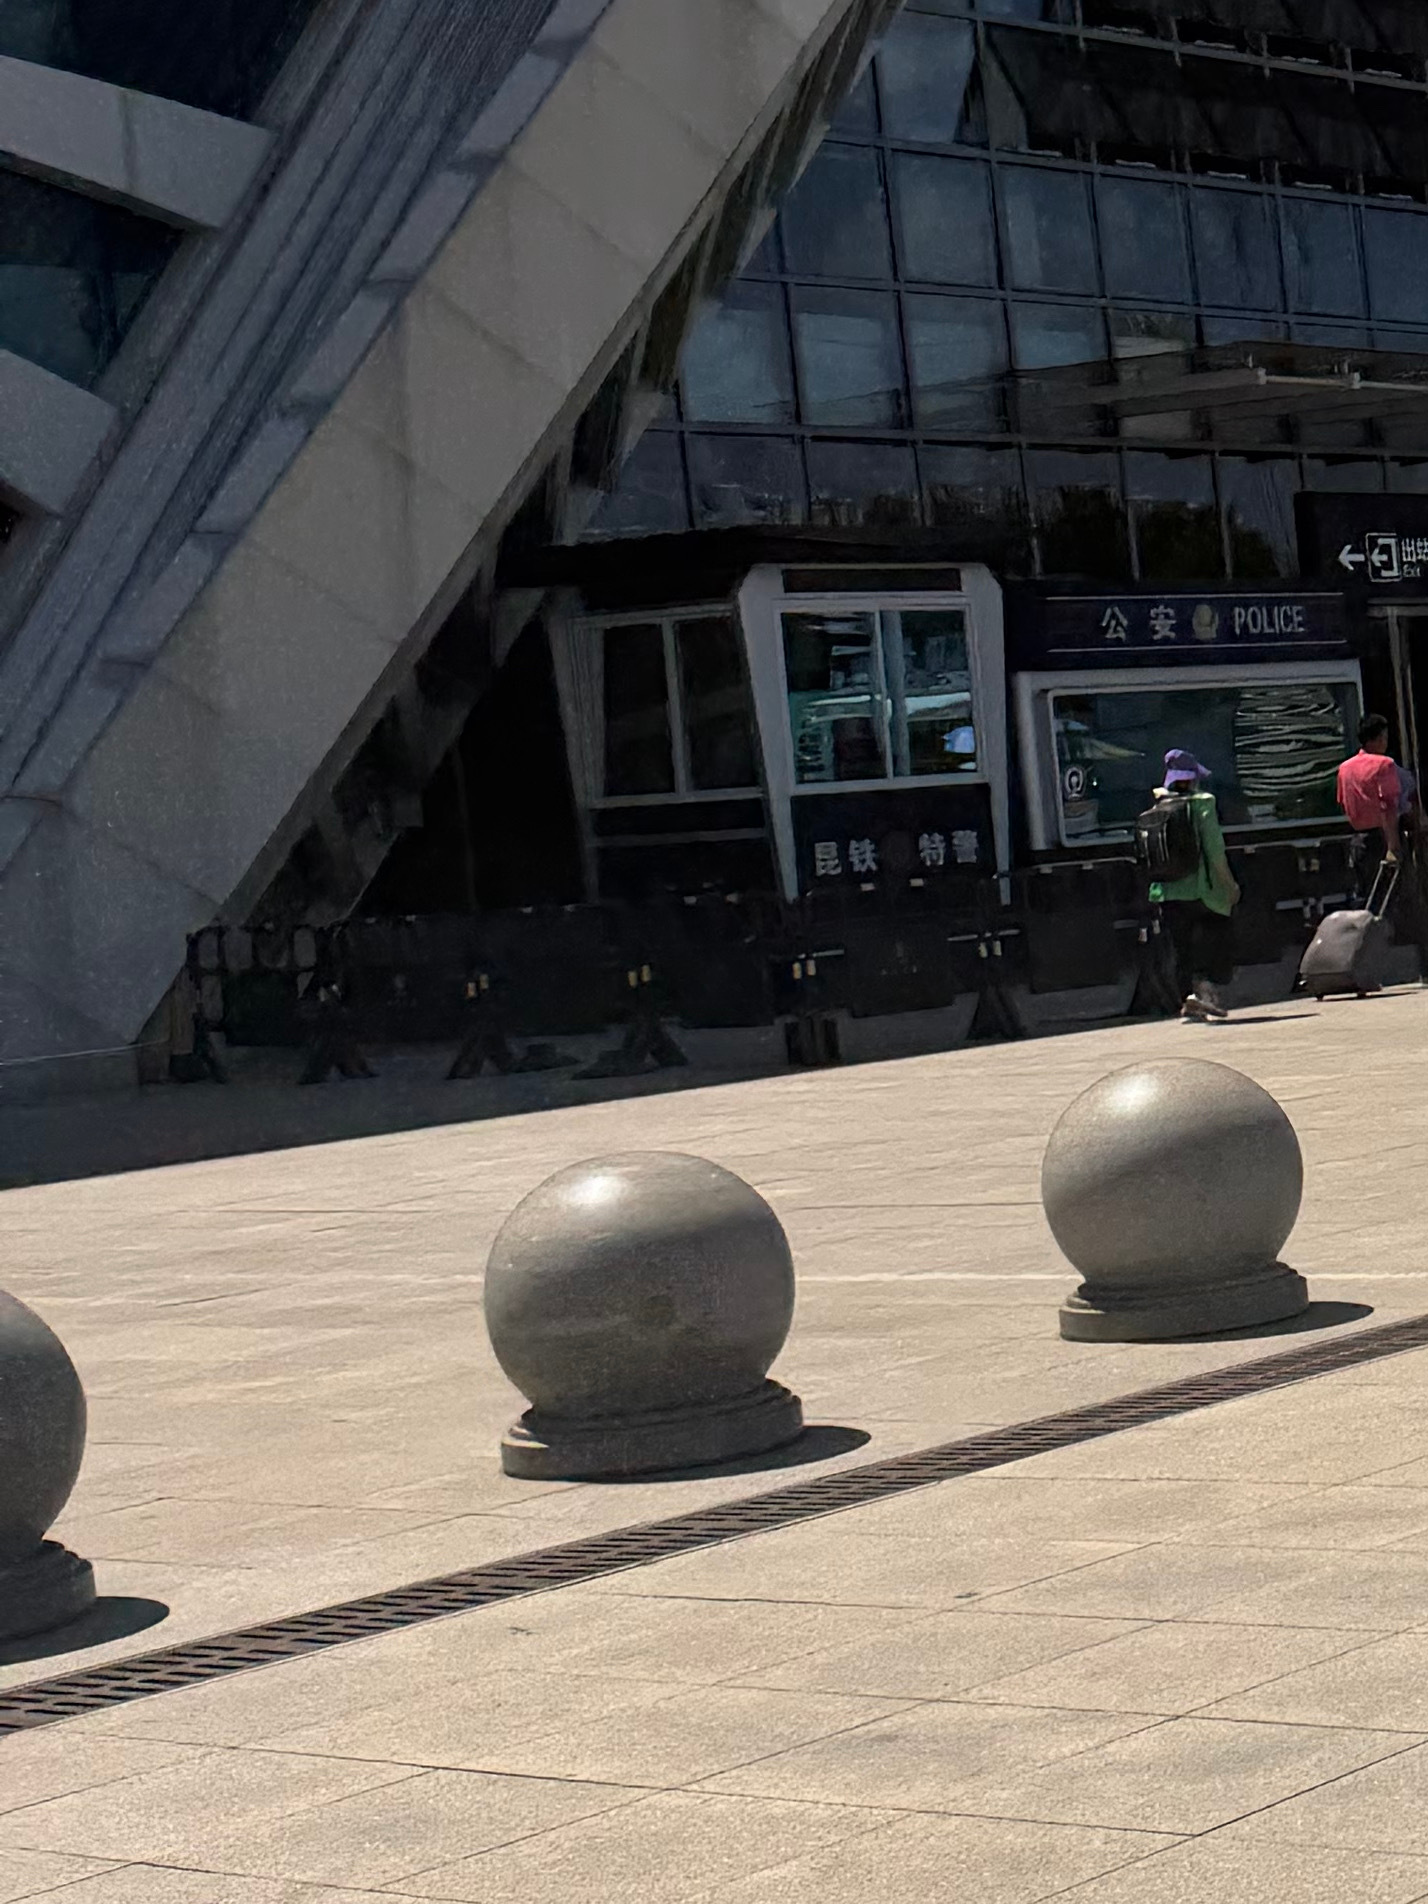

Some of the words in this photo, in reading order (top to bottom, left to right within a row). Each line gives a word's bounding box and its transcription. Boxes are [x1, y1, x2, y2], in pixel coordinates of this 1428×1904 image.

[1099, 604, 1177, 643] 公安
[1232, 605, 1306, 637] POLICE
[814, 838, 880, 878] 昆铁
[918, 829, 979, 867] 特警
